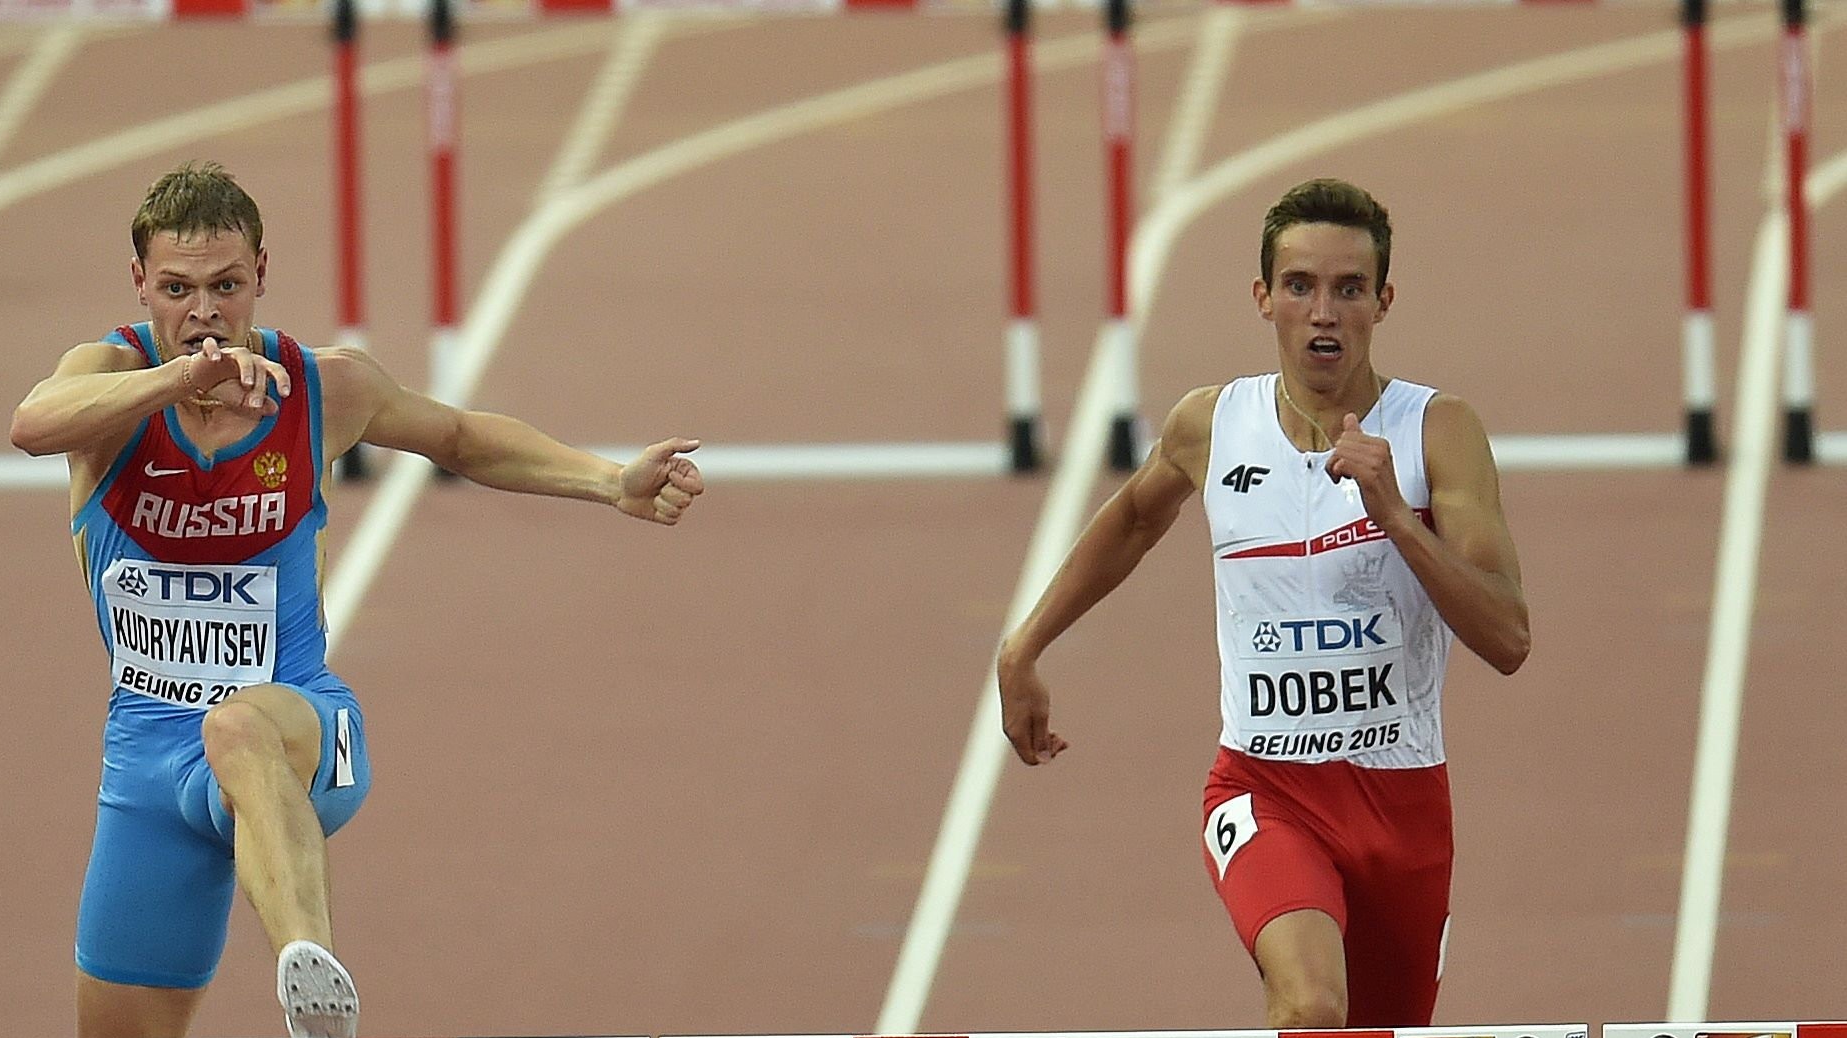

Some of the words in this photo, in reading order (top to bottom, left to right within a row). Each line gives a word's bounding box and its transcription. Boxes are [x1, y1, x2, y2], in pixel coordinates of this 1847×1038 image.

[1222, 464, 1270, 494] 4F
[132, 491, 286, 538] RUSSIA
[148, 569, 260, 605] TDK
[113, 607, 268, 667] KUDRYAVTSEV
[1280, 613, 1388, 651] TDK
[121, 666, 203, 704] BEIJING
[1249, 663, 1397, 718] DOBEK
[1249, 730, 1343, 755] BEIJING
[1348, 723, 1400, 750] 2015
[1217, 812, 1237, 855] 6
